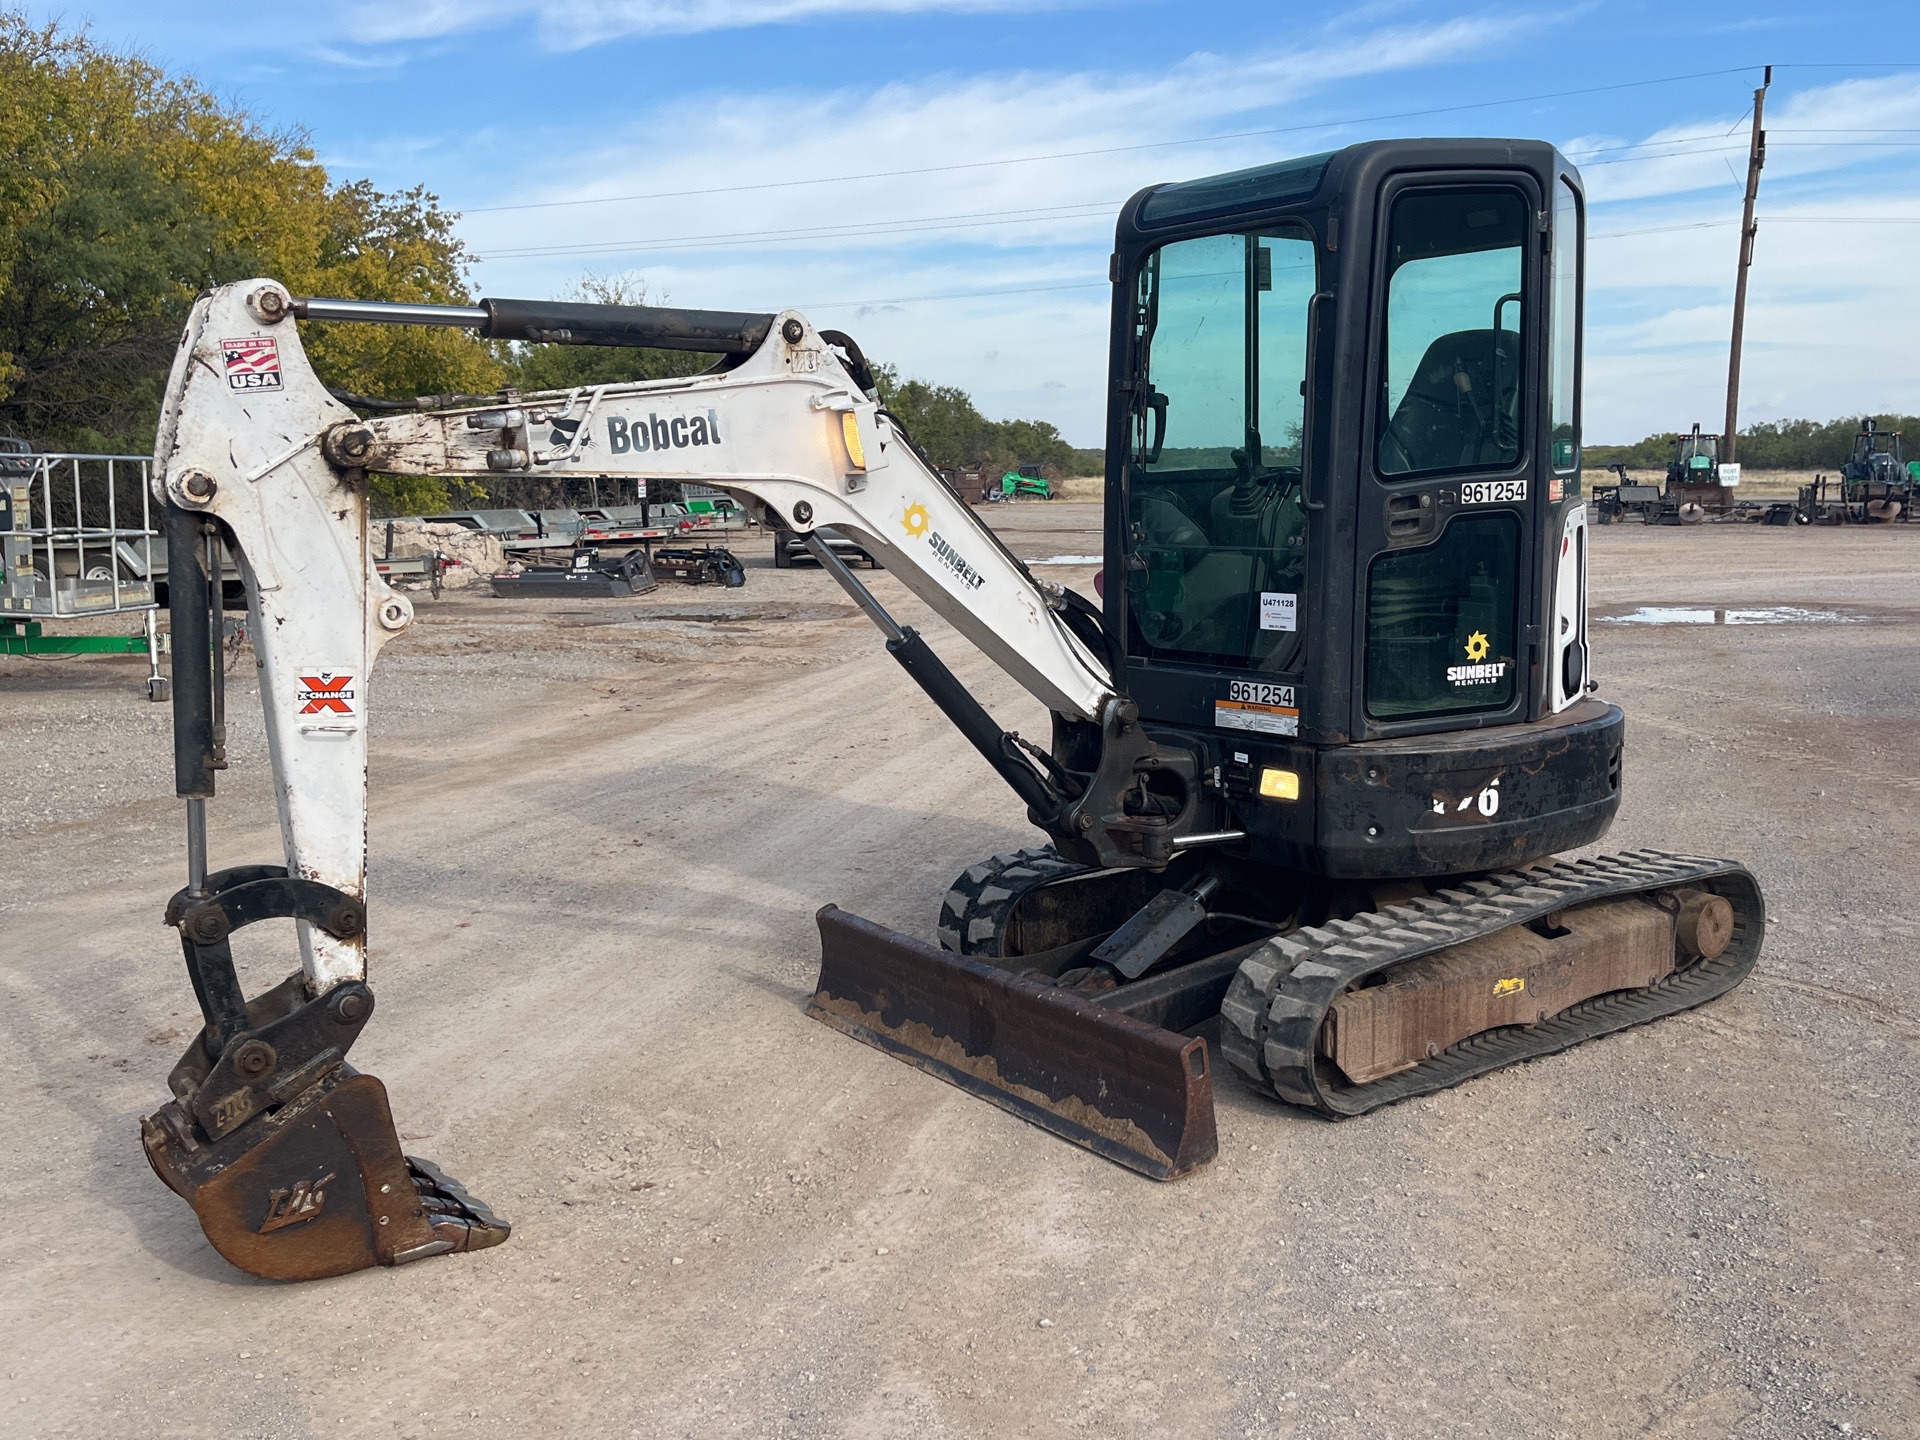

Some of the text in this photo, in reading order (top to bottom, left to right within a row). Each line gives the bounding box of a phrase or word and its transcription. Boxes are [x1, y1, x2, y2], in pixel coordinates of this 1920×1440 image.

[231, 373, 279, 388] USA
[606, 409, 721, 455] Bobcat
[1462, 482, 1525, 503] 961254
[928, 531, 986, 591] SUNBELT
[931, 550, 973, 590] RENTALS
[1262, 598, 1295, 608] U471128
[1446, 662, 1506, 681] SUNBELT
[1454, 677, 1498, 687] RENTALS
[299, 691, 353, 700] X-CHANGE
[1231, 682, 1293, 706] 961254
[1247, 704, 1272, 713] WARNING
